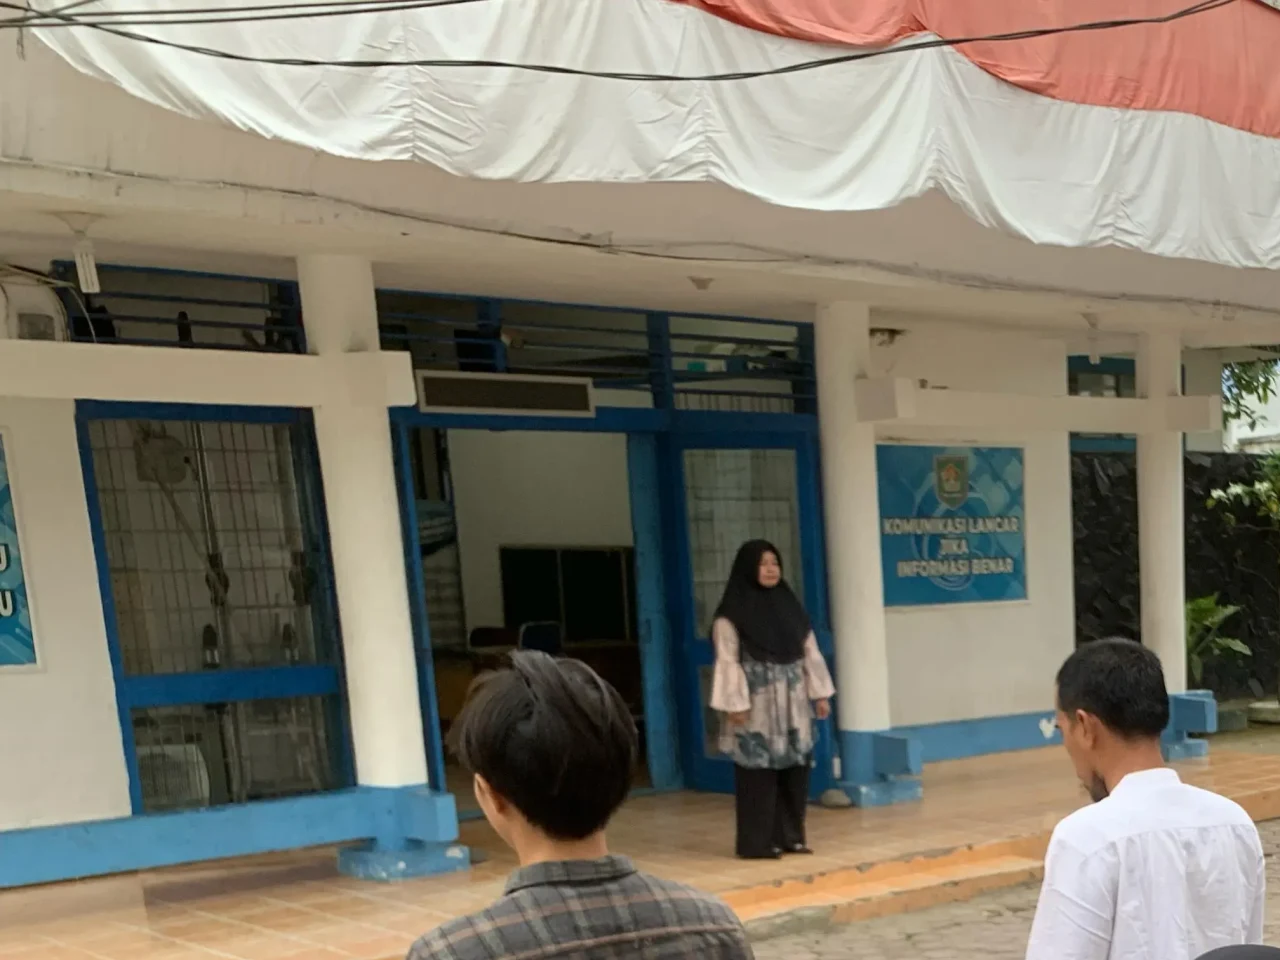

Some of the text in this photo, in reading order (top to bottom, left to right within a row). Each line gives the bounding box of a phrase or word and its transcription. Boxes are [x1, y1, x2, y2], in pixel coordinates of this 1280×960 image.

[883, 516, 1018, 534] KOMUNIKASI LANCAR
[940, 538, 969, 555] JIKA
[897, 557, 1014, 577] INFORMASI BENAR
